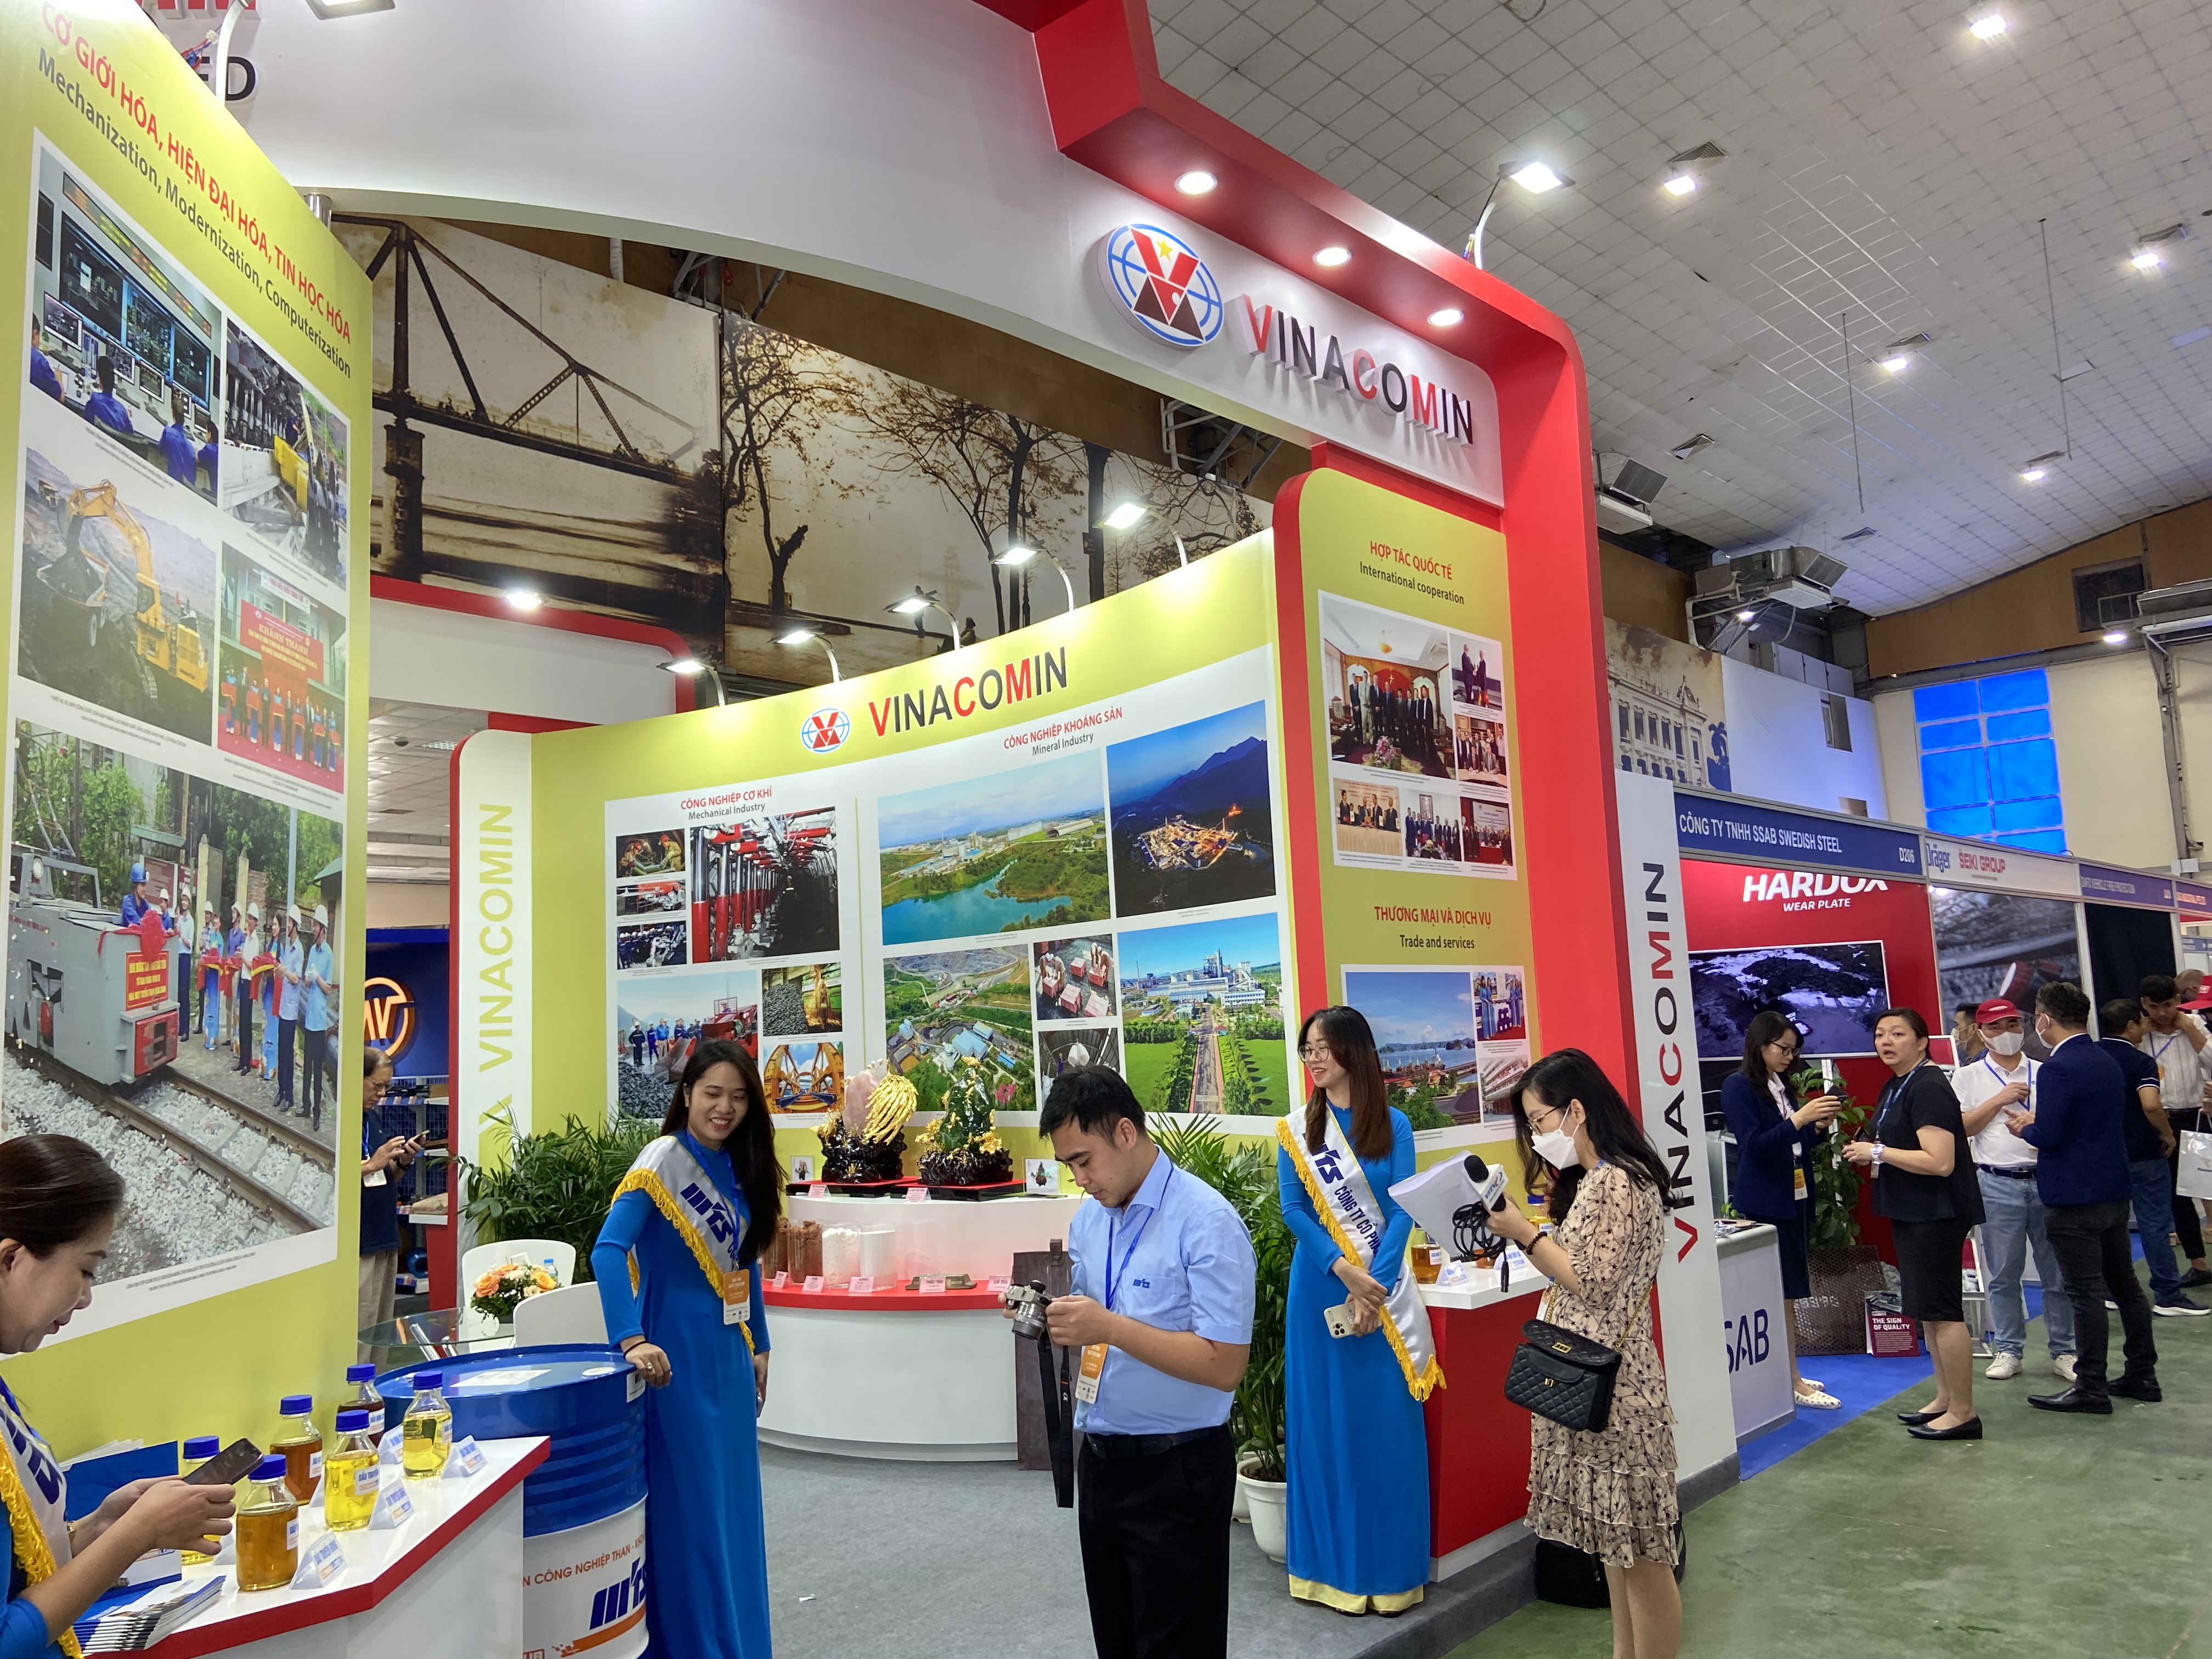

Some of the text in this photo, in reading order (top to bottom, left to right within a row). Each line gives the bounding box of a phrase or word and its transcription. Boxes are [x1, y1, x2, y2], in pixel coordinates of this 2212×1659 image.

[42, 1, 351, 345] CƠ GIỚI HÓA, HIỆN ĐẠI HÓA, TIN HỌC HÓA
[38, 46, 351, 379] Mechanization, Modernization, Computerization
[1239, 293, 1474, 445] VINACOMIN
[1370, 540, 1453, 580] HỢP TÁC QUỐC TẾ
[1359, 561, 1465, 605] International cooperation
[868, 646, 1068, 737] VINACOMIN
[1004, 706, 1122, 749] CÔNG NGHIỆP KHOÁNG SẢN
[1032, 732, 1094, 757] Mineral Industry
[681, 785, 772, 810] CÔNG NGHIỆP CƠ KHÍ
[689, 803, 765, 820] Mechanical Industry
[1679, 810, 1843, 854] CÔNG TY TNHH SSAB SWEDISH STEEL
[1898, 847, 1915, 864] D206
[1978, 855, 2006, 874] GROUP
[1374, 905, 1492, 929] THƯƠNG MẠI VÀ DỊCH VỤ
[1782, 897, 1851, 912] WEAR PLATE
[479, 804, 513, 1073] VINACOMIN
[1400, 934, 1475, 949] Trade and services
[1643, 862, 1699, 1263] VINACOMIN
[1334, 1185, 1357, 1212] CÔNG
[1349, 1207, 1366, 1222] TY
[534, 1567, 573, 1585] CÔNG
[575, 1553, 611, 1576] NGHIỆP
[612, 1543, 631, 1562] THAN
